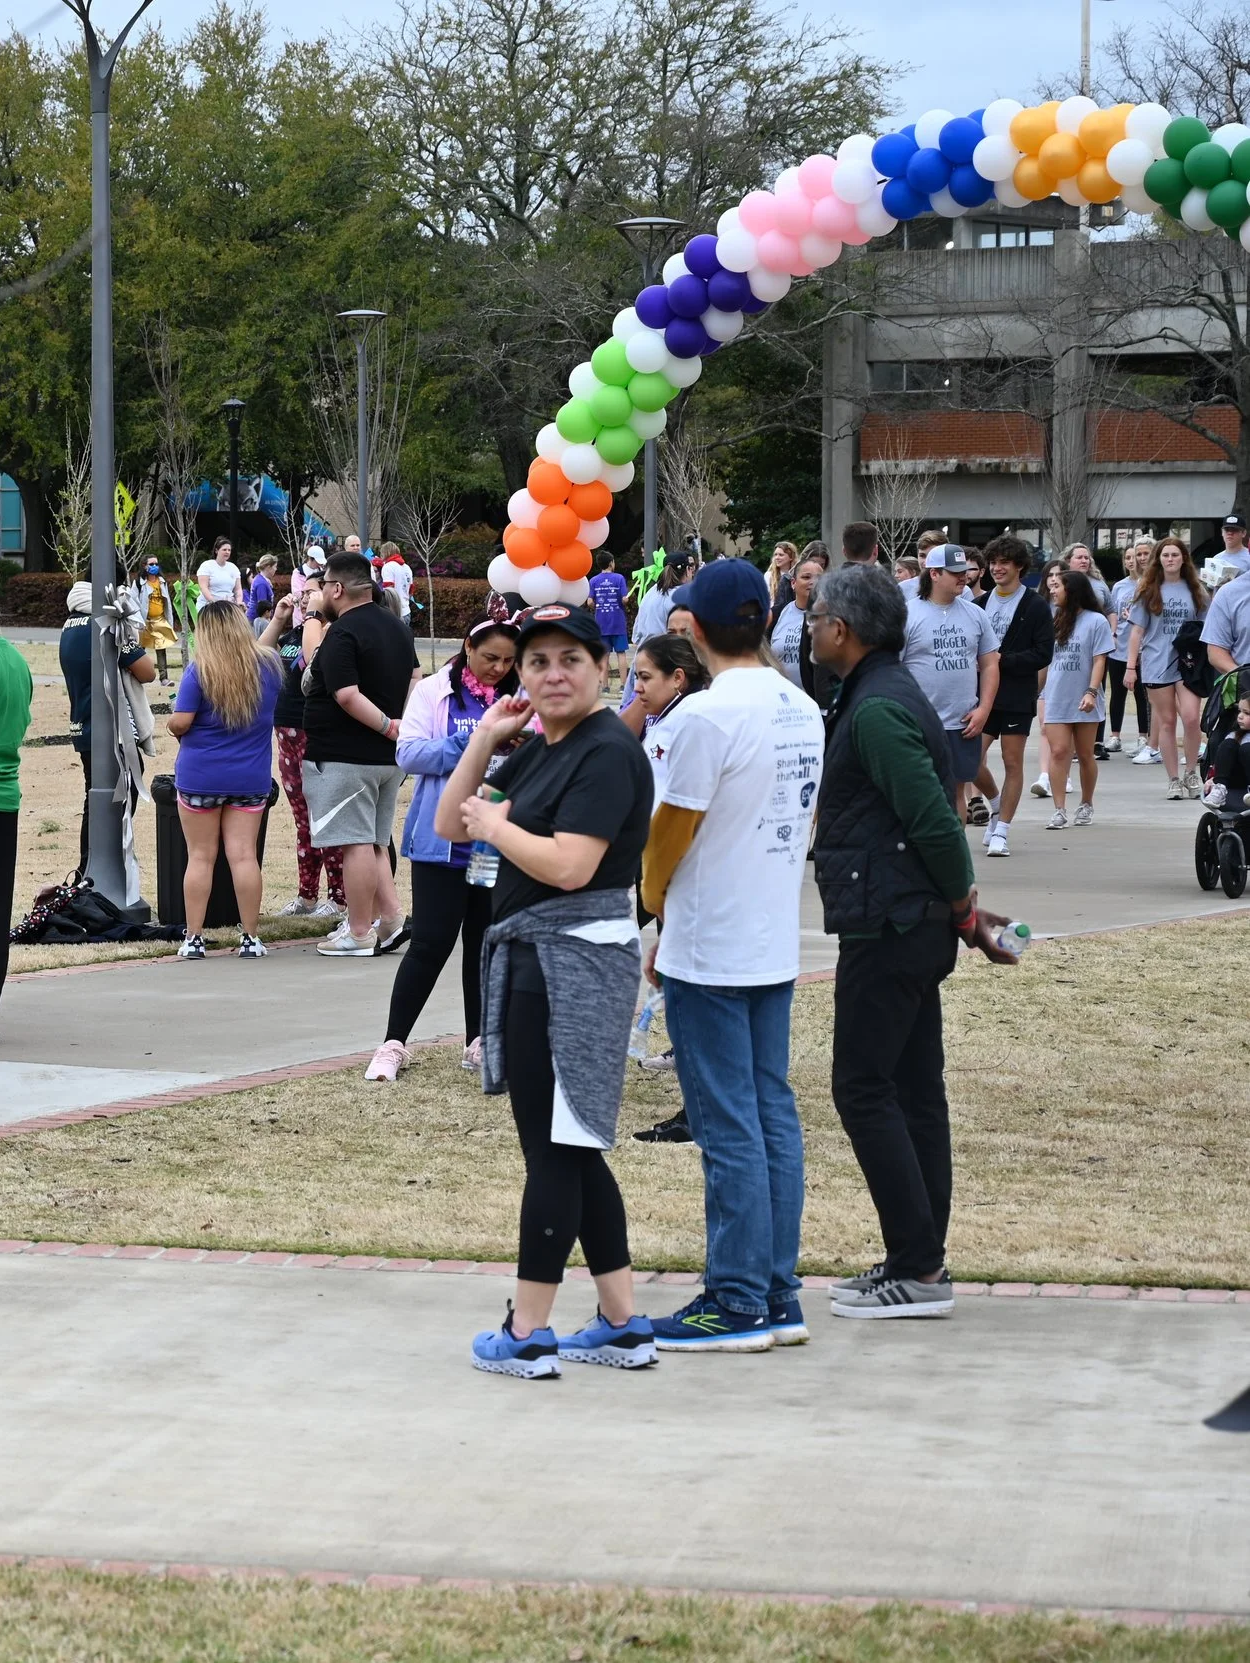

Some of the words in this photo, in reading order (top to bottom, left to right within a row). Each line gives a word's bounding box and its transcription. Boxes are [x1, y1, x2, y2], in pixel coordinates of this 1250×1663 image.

[1163, 608, 1189, 618] BIGGER
[940, 624, 957, 637] God
[785, 635, 800, 644] BIG
[933, 636, 967, 649] BIGGER
[783, 653, 799, 664] CAN
[935, 658, 969, 671] CANCER
